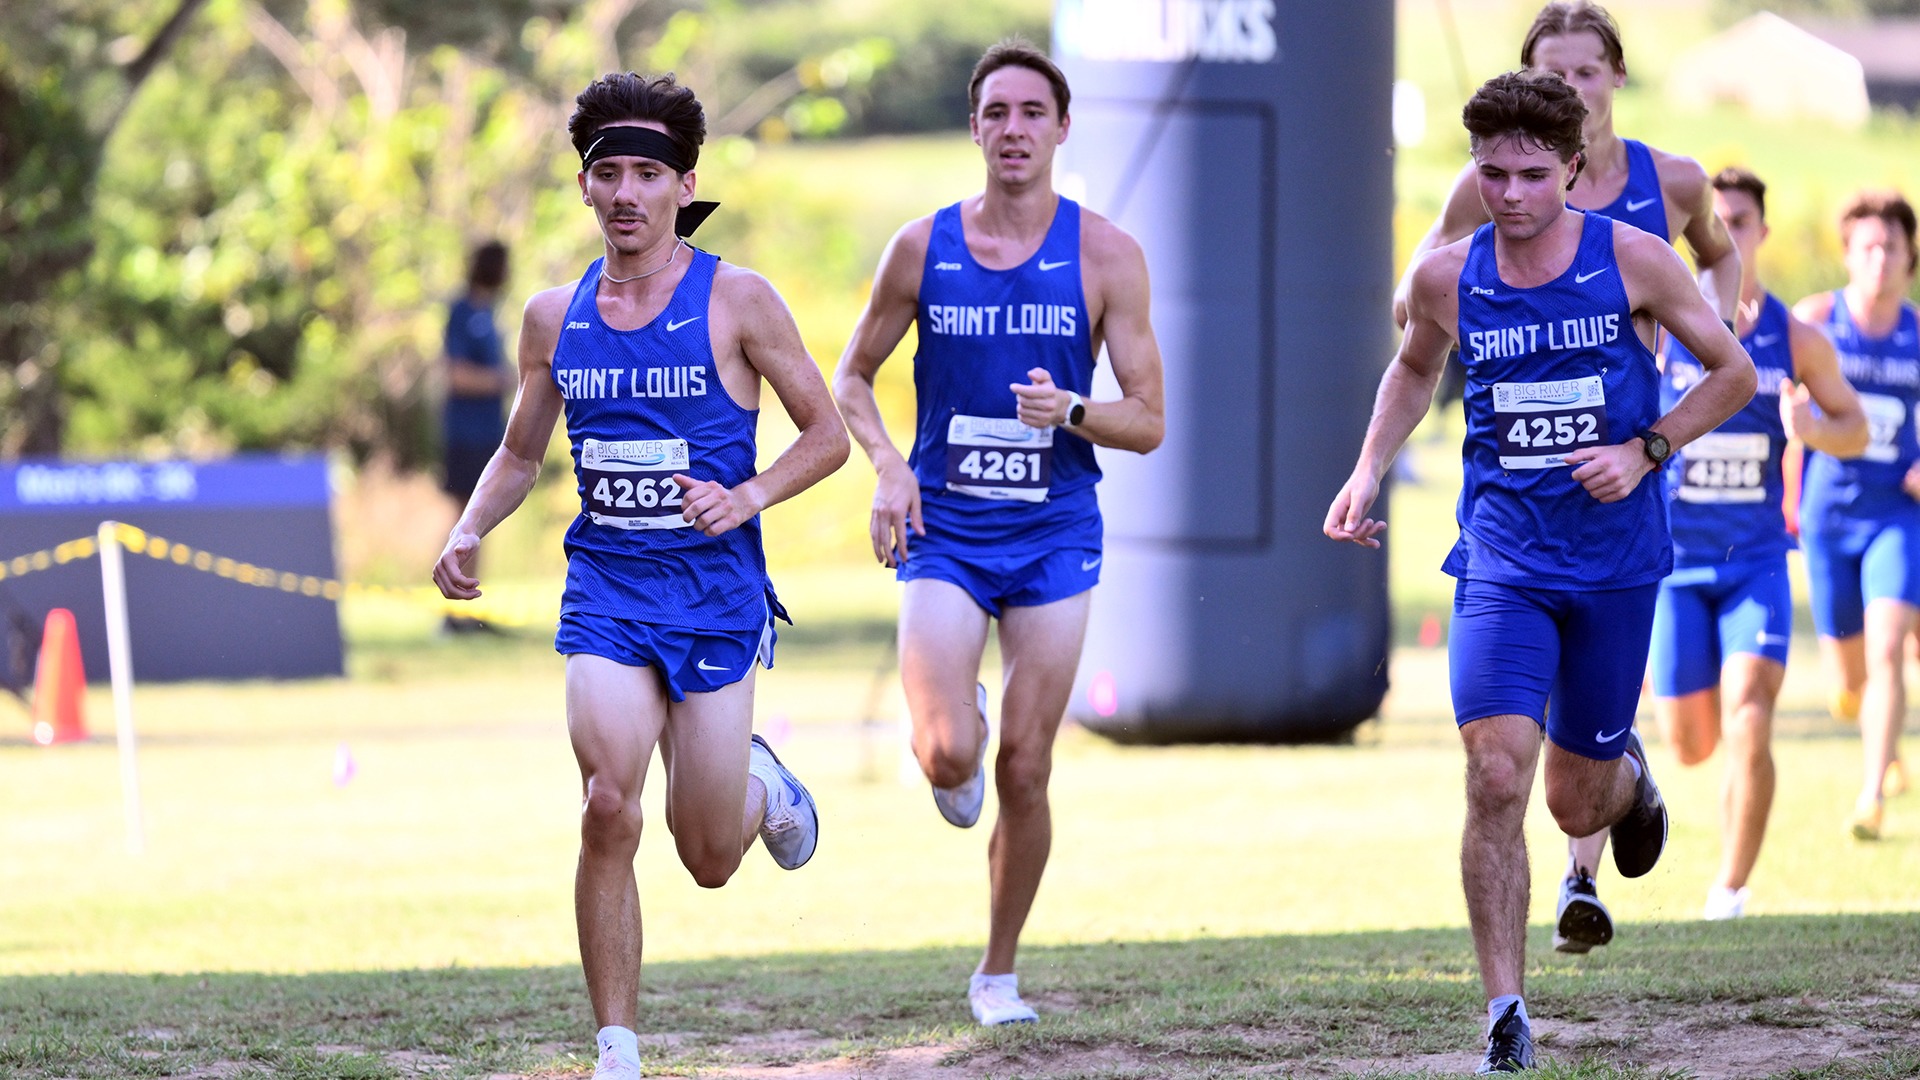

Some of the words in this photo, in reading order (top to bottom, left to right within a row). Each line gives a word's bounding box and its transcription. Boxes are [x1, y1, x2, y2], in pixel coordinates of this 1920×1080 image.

[565, 321, 590, 331] A10
[928, 304, 1000, 336] SAINT
[1006, 303, 1076, 337] LOUIS
[1469, 324, 1540, 361] SAINT
[1548, 313, 1619, 350] LOUIS
[557, 368, 624, 399] SAINT
[631, 366, 707, 398] LOUIS
[1513, 384, 1536, 396] BIG
[1539, 381, 1579, 395] RIVER
[1507, 413, 1599, 448] 4252
[597, 442, 619, 455] BIG
[622, 441, 664, 454] RIVER
[958, 450, 1041, 482] 4261
[592, 476, 683, 508] 4262
